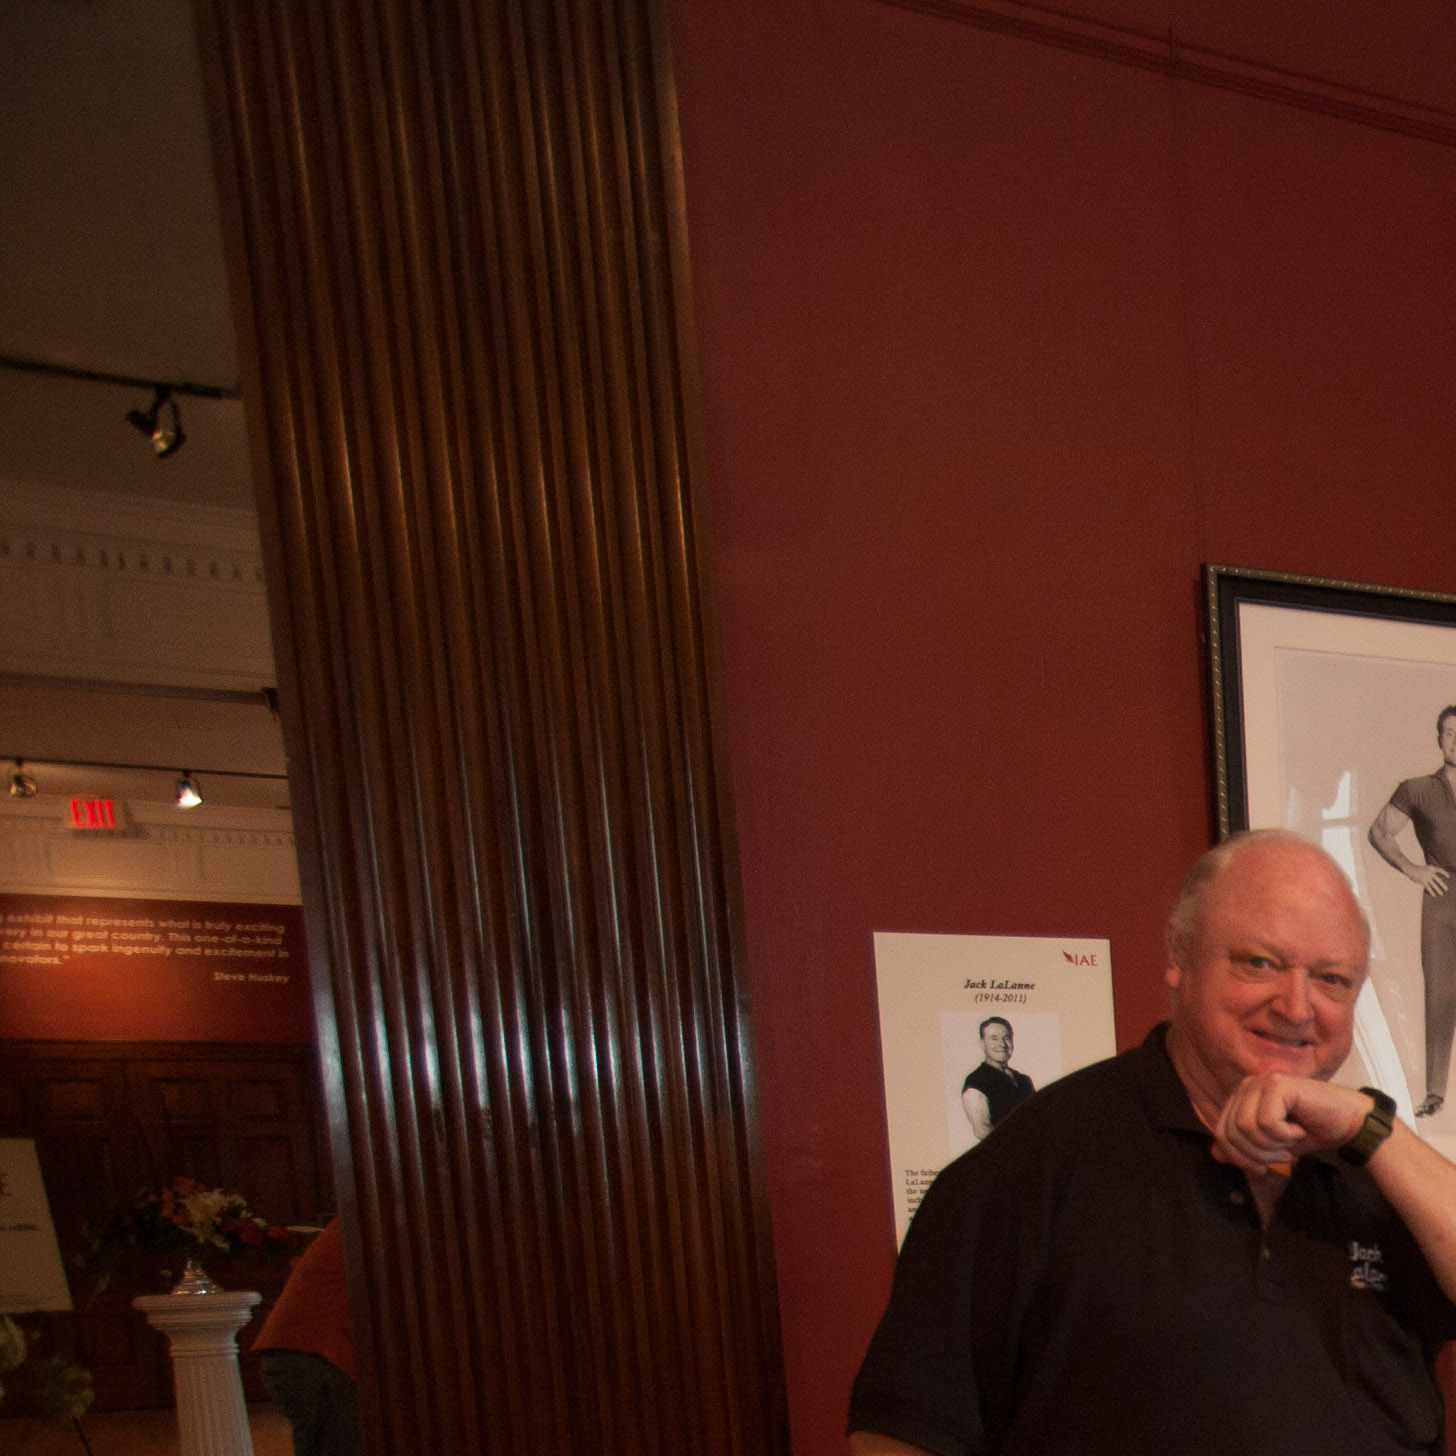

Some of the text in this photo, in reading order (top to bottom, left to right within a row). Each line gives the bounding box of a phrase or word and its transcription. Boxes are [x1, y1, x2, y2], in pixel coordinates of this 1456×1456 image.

[71, 799, 115, 828] EXIT
[72, 930, 109, 941] great
[964, 979, 1036, 990] Jack LaLanne
[974, 992, 1028, 1004] (1914-2011)
